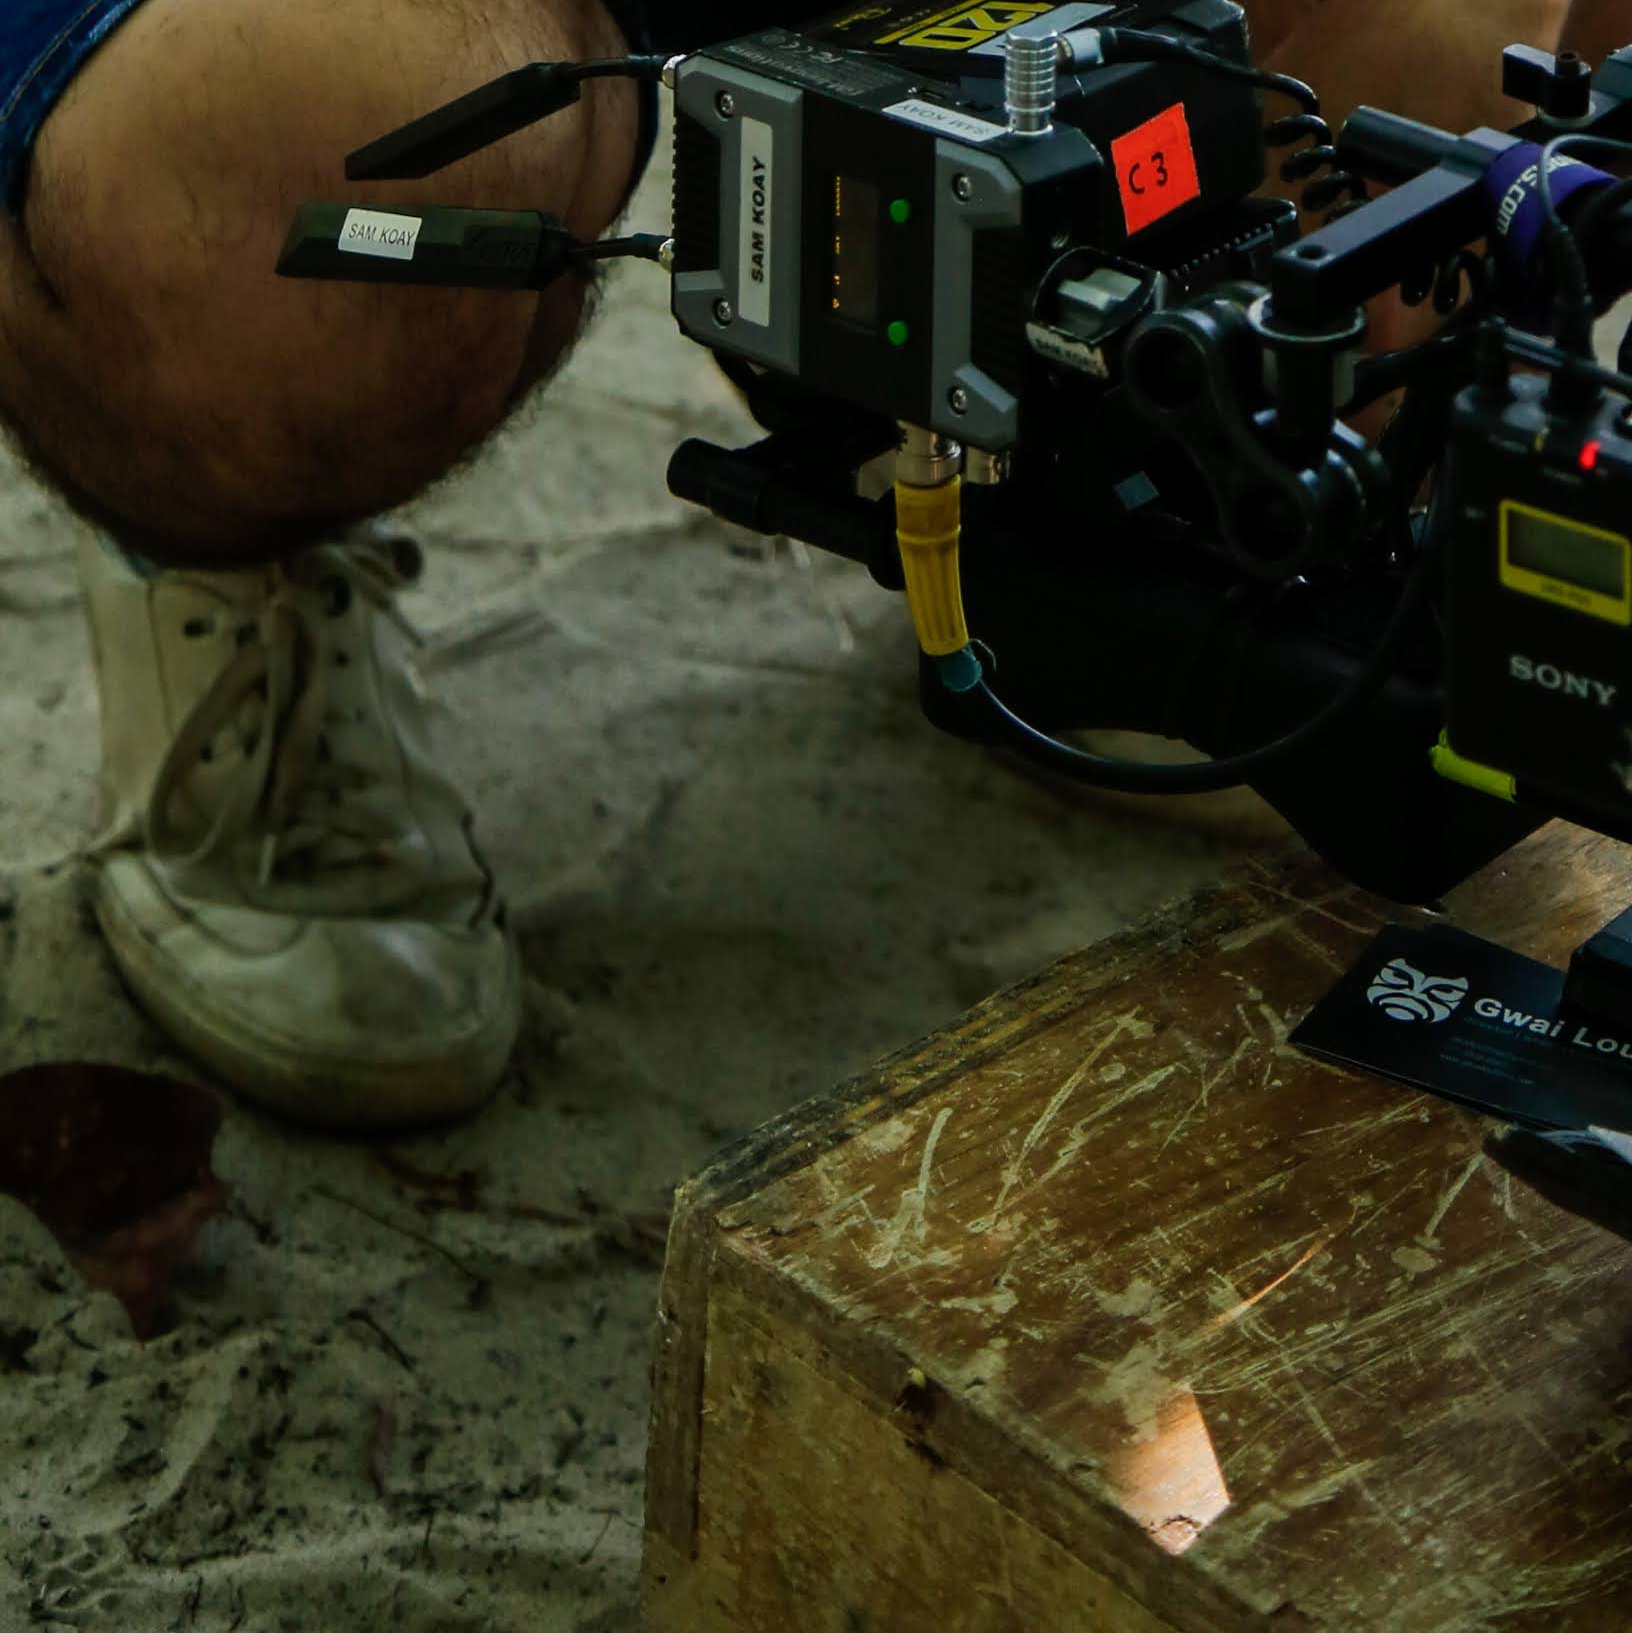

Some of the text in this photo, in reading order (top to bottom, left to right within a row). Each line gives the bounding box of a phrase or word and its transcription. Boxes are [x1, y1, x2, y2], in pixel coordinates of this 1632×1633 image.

[898, 0, 1056, 51] 120
[902, 102, 989, 137] SAM KOAY
[348, 223, 416, 247] SAM KOAY
[751, 156, 767, 283] SAM KOAY
[1508, 653, 1617, 709] SONY
[1474, 997, 1566, 1039] Gwai
